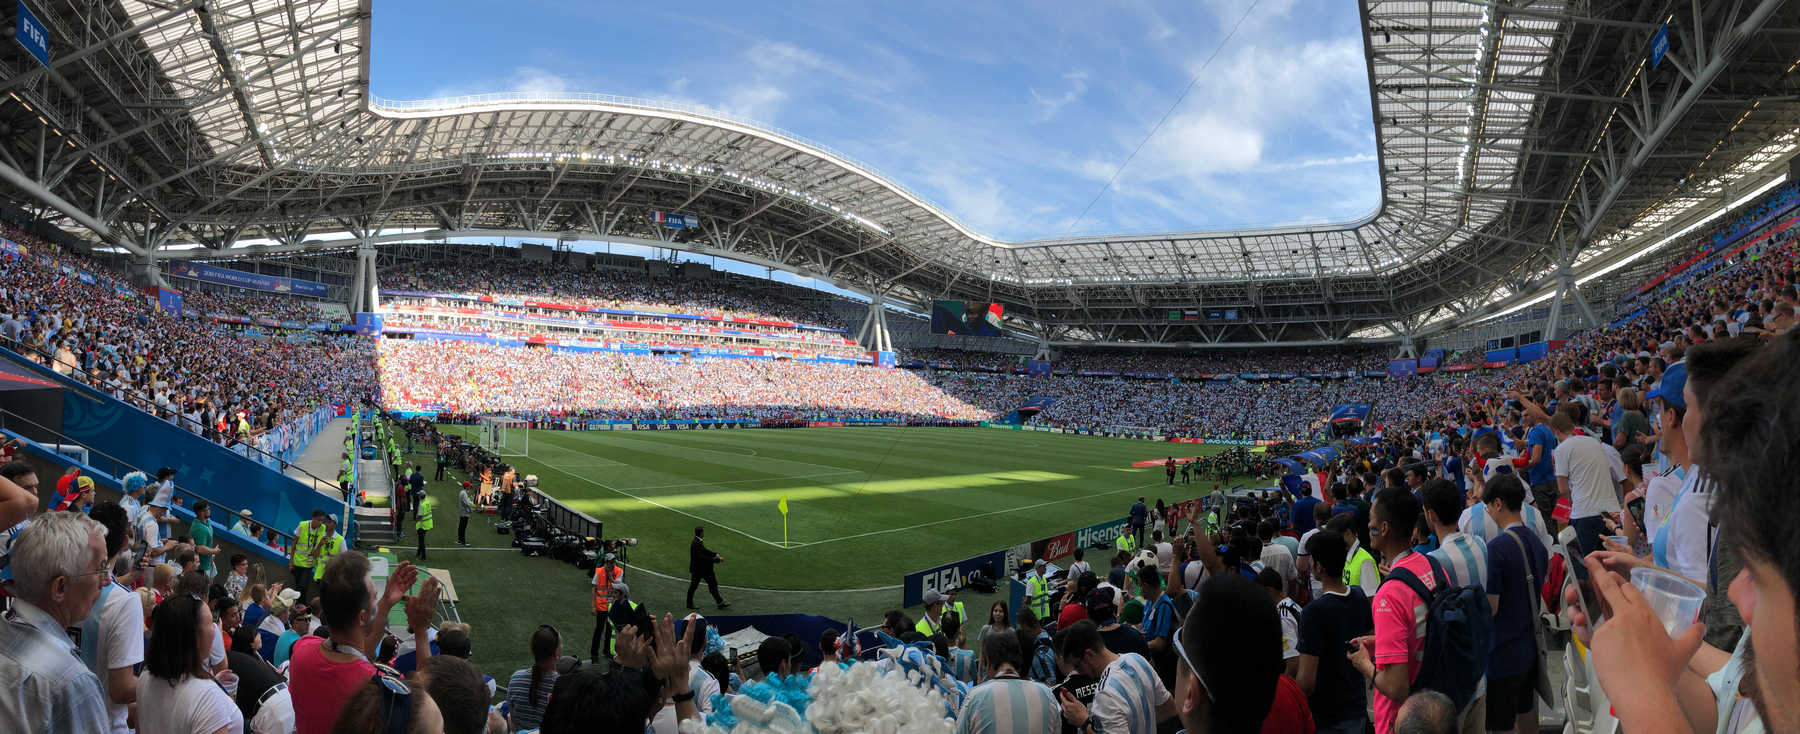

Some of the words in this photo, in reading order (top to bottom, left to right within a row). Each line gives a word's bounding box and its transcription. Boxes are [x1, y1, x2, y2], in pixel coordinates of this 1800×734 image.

[23, 17, 47, 52] FIFA
[1655, 35, 1667, 57] FIFA
[668, 217, 682, 225] FIFA
[1078, 523, 1128, 548] Hisense
[1048, 538, 1070, 559] Bud
[1076, 683, 1098, 698] MESS
